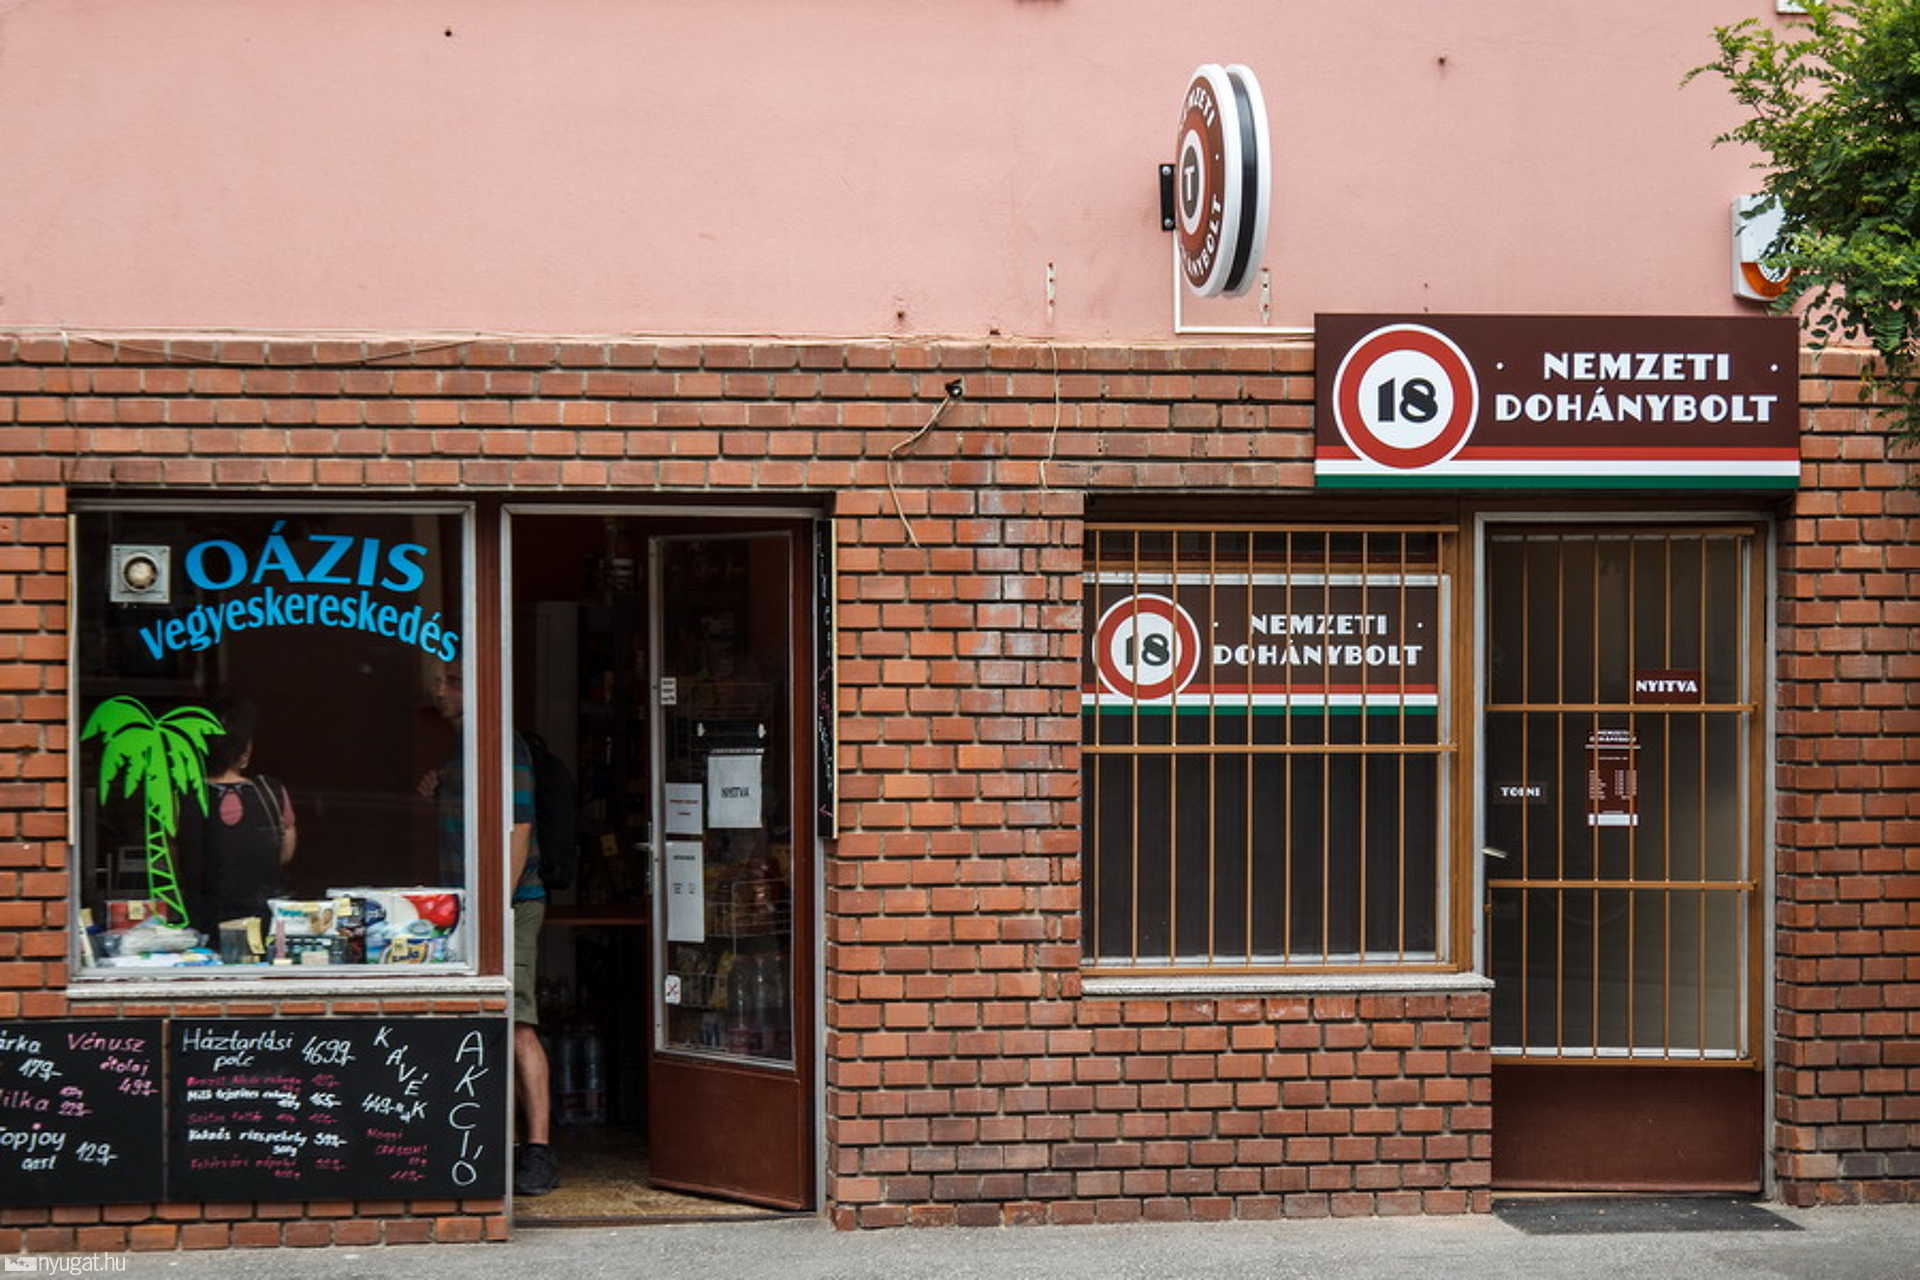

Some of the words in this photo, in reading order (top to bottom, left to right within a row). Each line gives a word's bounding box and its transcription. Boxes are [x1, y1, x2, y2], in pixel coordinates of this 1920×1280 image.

[1184, 166, 1195, 201] T
[1543, 353, 1730, 381] NEMZETI
[1377, 377, 1439, 424] 18
[1495, 387, 1778, 423] DOHÁNYBOLT
[184, 520, 429, 592] OÁZIS
[139, 586, 459, 662] Vegyeskereskedés
[1251, 614, 1388, 635] NEMZETI
[1125, 632, 1171, 667] 18
[1213, 638, 1423, 666] DOHÁNYBOLT
[1635, 680, 1698, 692] NYITVA
[67, 1031, 147, 1052] Vénusz
[182, 1028, 294, 1051] Háztartási
[213, 1052, 256, 1071] polc
[0, 1089, 51, 1112] ilka
